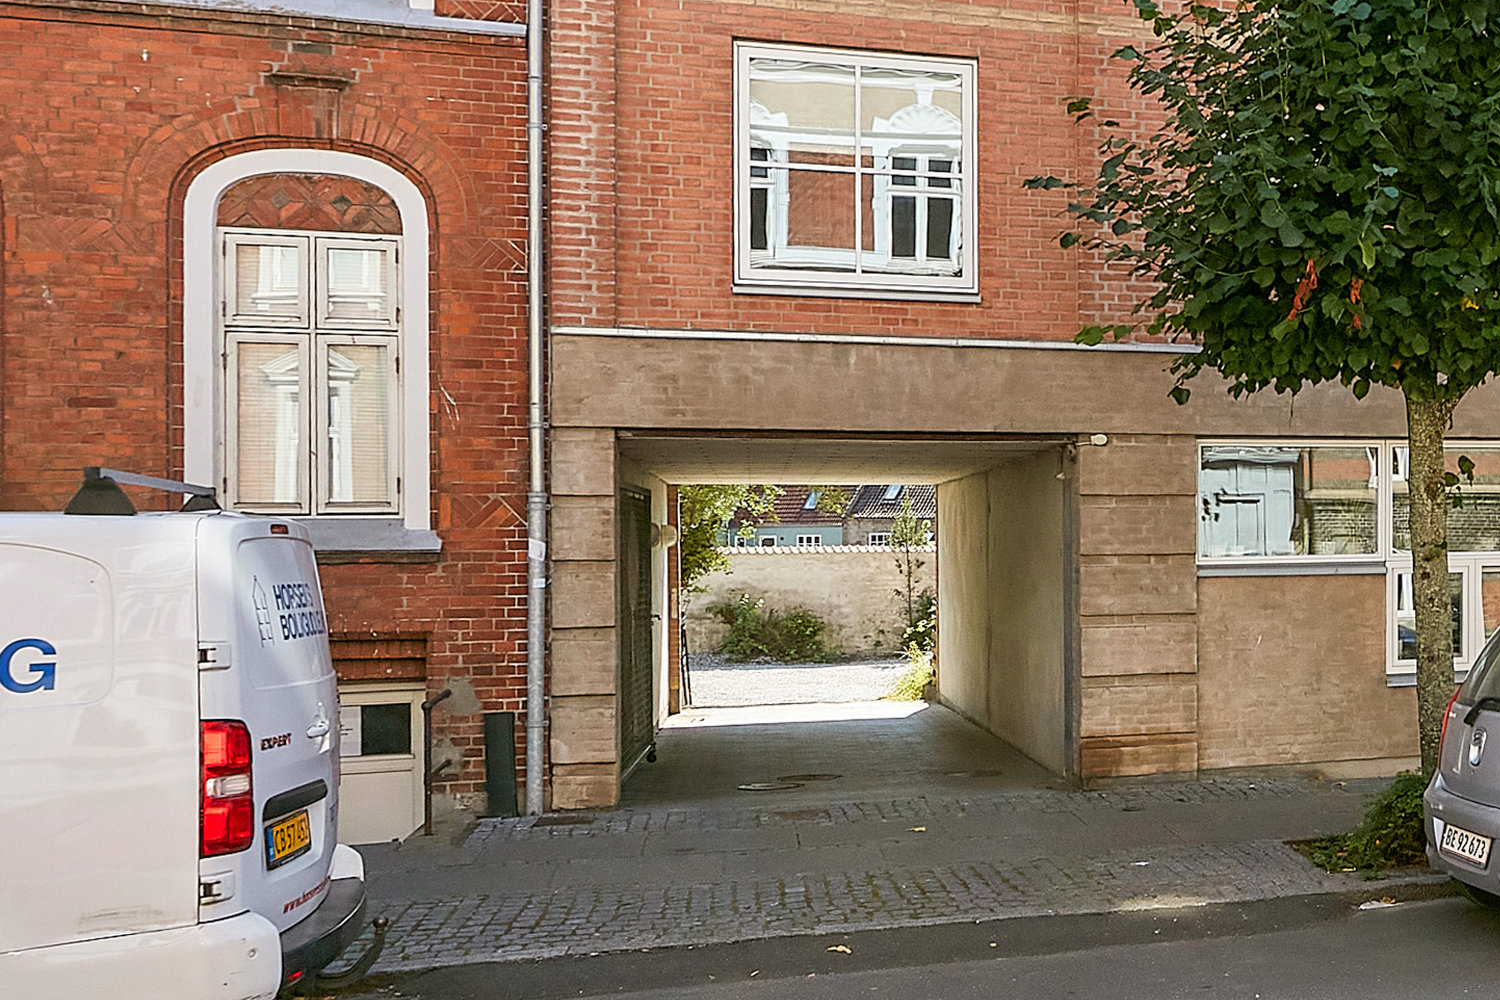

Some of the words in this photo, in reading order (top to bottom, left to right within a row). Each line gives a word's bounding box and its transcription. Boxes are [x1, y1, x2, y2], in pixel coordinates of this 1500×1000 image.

[0, 638, 56, 693] G
[260, 733, 291, 751] EXPERT
[274, 828, 286, 854] CB
[287, 823, 296, 848] 57
[1445, 828, 1457, 847] BE
[1457, 832, 1469, 852] 92
[1468, 836, 1487, 859] 673
